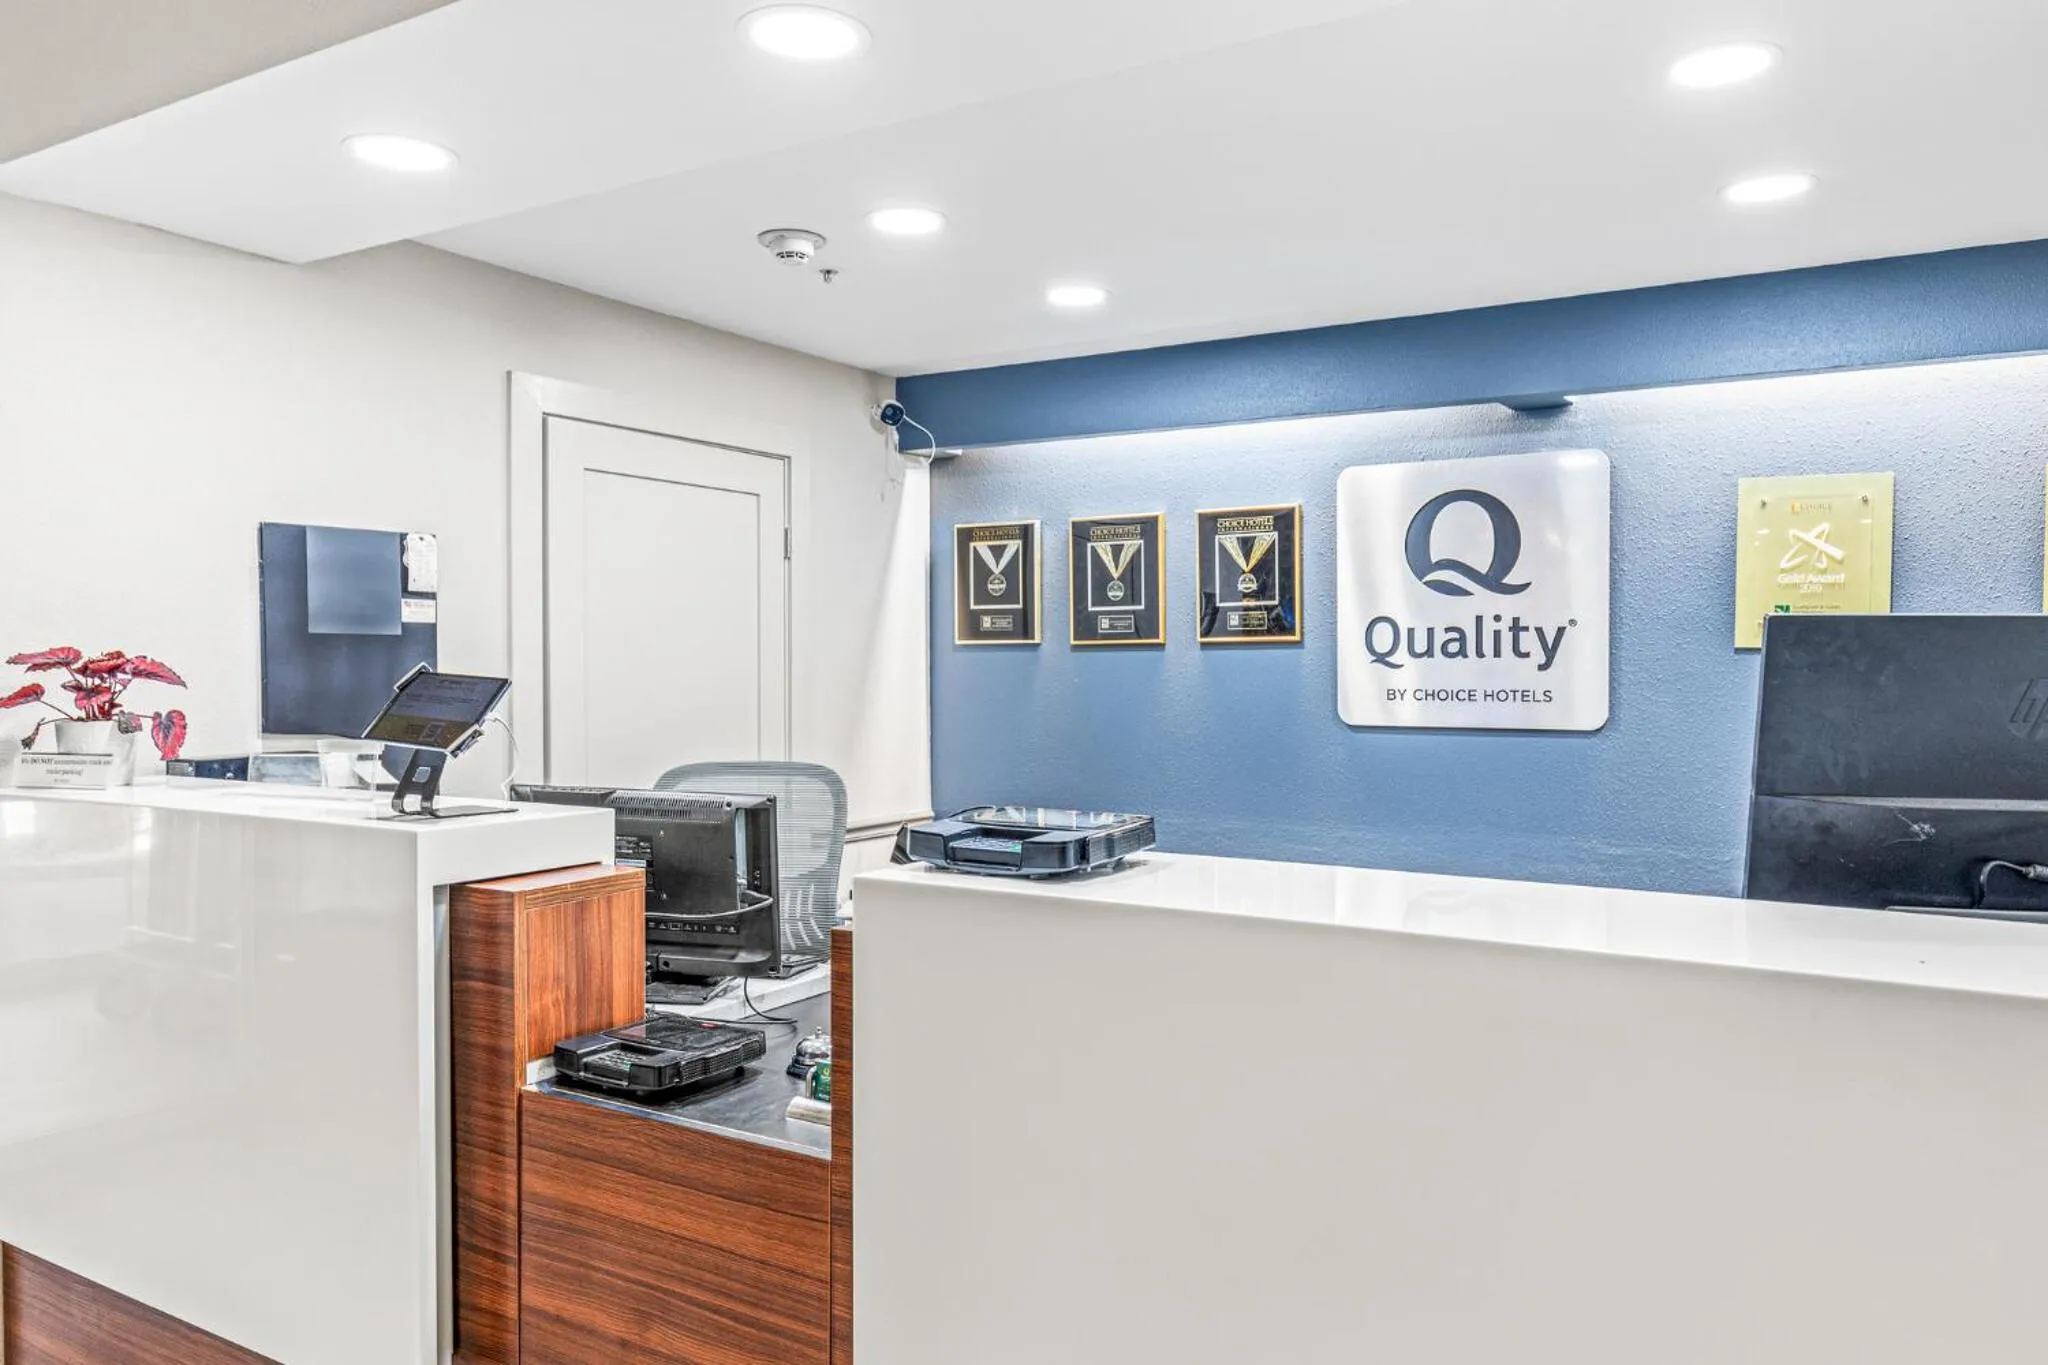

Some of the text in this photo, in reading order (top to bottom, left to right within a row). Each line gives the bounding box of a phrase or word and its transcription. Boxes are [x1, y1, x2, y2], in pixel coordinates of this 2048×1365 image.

[1405, 489, 1532, 596] Q
[1387, 688, 1552, 702] BY CHOICE HOTELS
